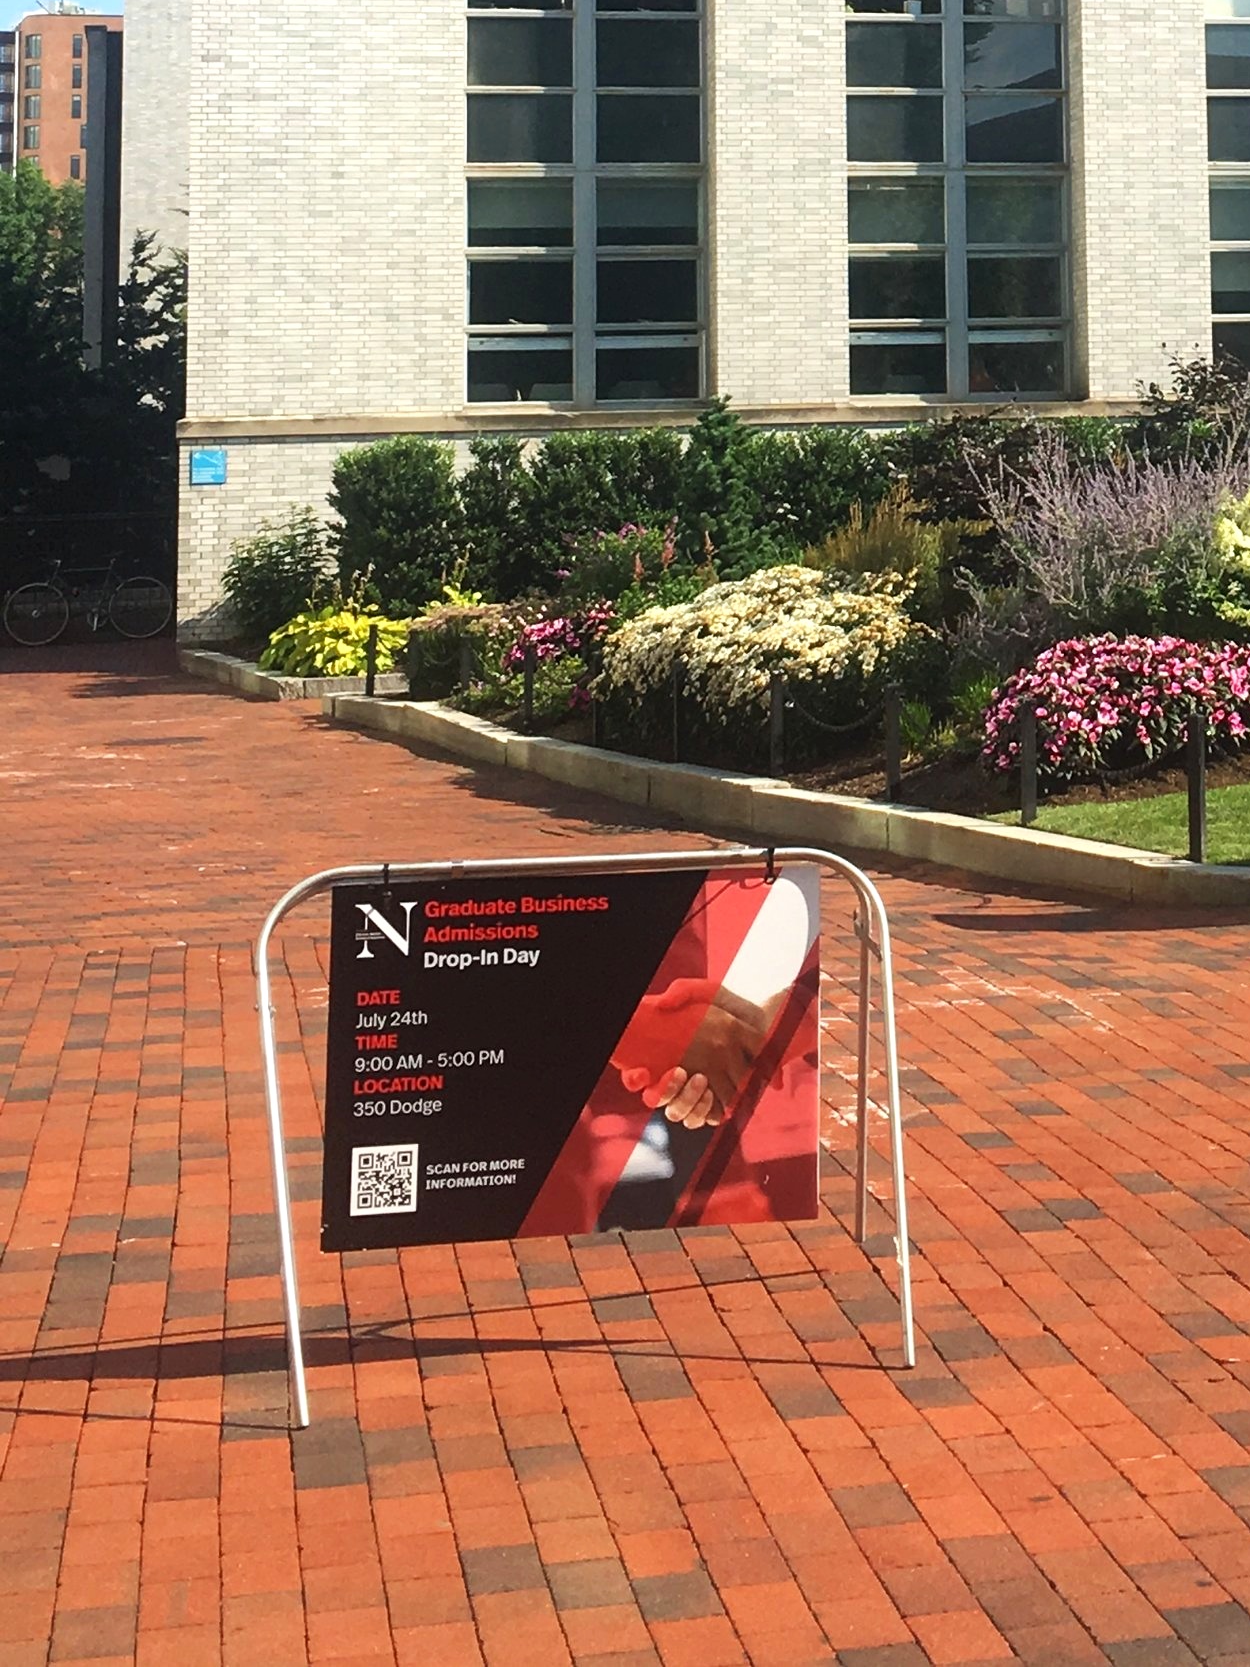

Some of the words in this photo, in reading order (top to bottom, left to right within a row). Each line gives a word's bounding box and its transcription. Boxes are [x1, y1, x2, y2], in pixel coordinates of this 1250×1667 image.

[424, 898, 517, 918] Graduate
[520, 895, 609, 914] Business
[354, 901, 418, 959] N
[423, 922, 539, 943] Admissions
[423, 949, 499, 970] Drop-In
[503, 948, 541, 967] Day
[356, 990, 401, 1006] DATE
[355, 1013, 387, 1030] July
[390, 1011, 428, 1027] 24th
[355, 1034, 398, 1050] TIME
[354, 1056, 393, 1073] 9:00
[396, 1054, 423, 1070] AM
[437, 1051, 475, 1068] 5:00
[479, 1049, 505, 1065] PM
[353, 1075, 444, 1095] LOCATION
[353, 1101, 386, 1117] 350
[390, 1098, 443, 1115] Dodge
[426, 1163, 461, 1175] SCAN
[462, 1161, 488, 1173] FOR
[489, 1159, 526, 1171] MORE
[425, 1174, 517, 1190] INFORMATION!
